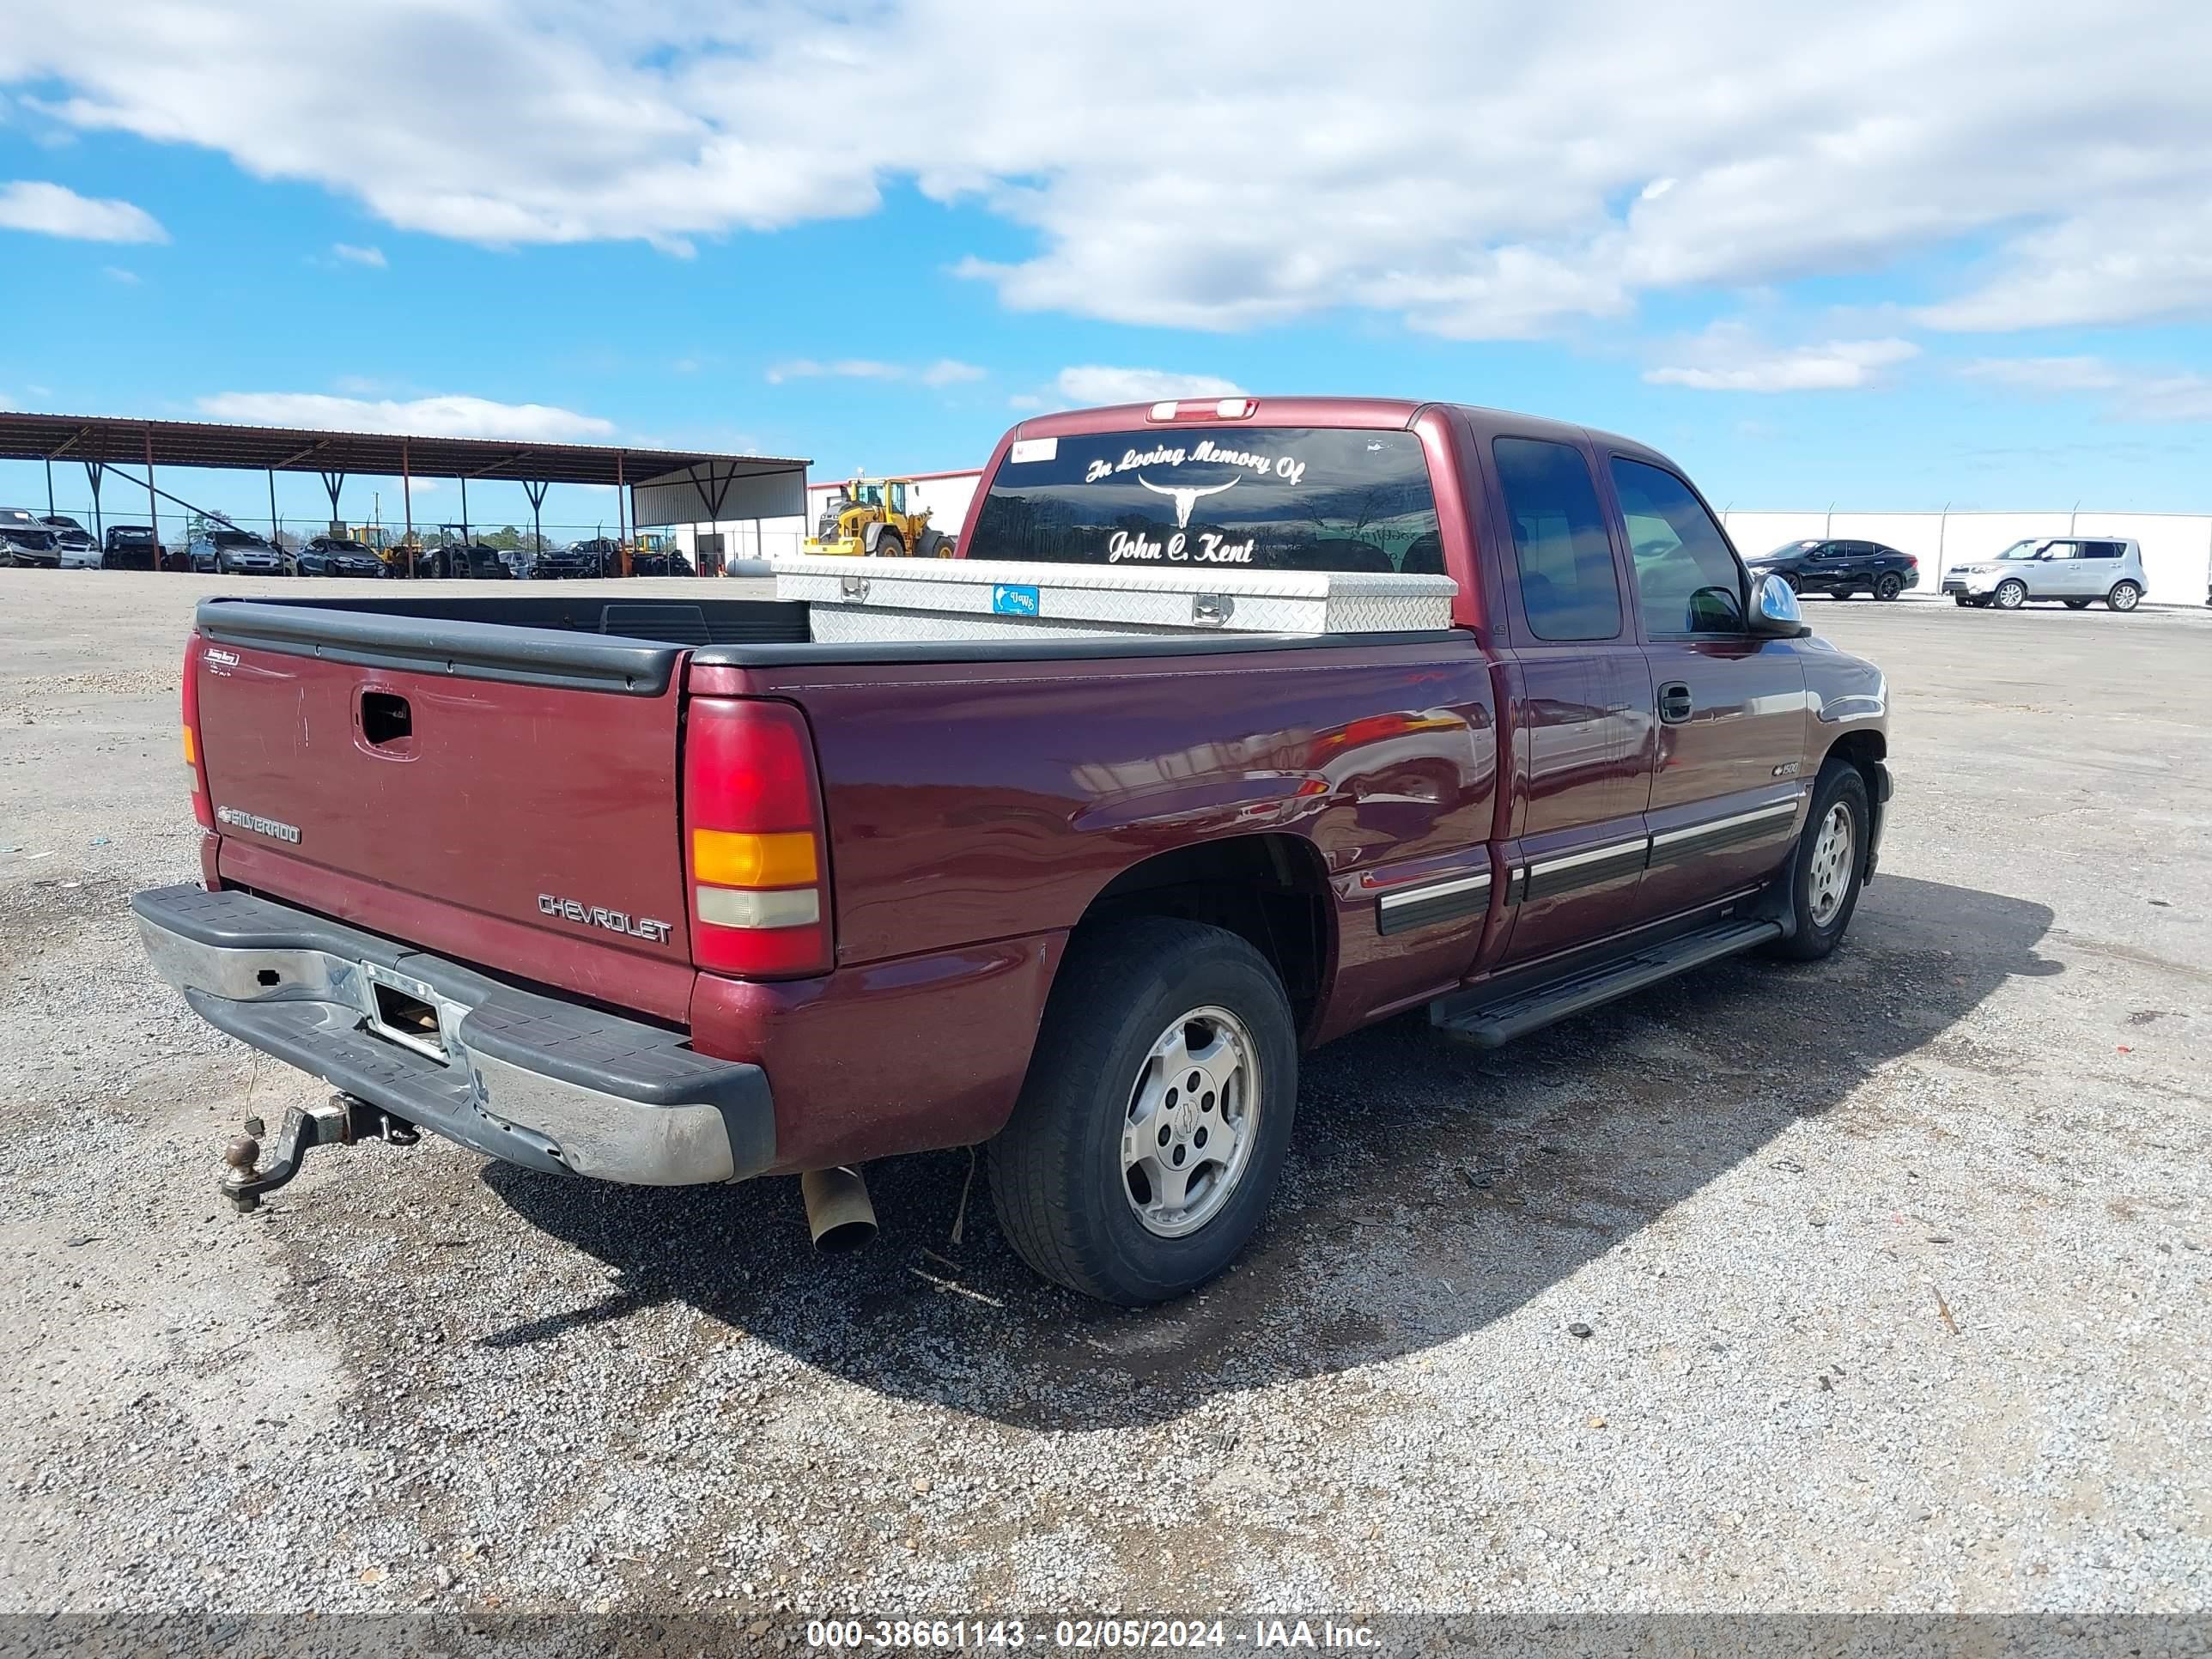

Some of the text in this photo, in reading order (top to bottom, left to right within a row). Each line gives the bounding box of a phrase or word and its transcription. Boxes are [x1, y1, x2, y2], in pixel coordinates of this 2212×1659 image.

[1085, 440, 1306, 486] In Loving Memory Of
[1109, 531, 1255, 563] John C. Kent
[231, 809, 301, 845] SILVERADO
[538, 893, 674, 945] CHEVROLET
